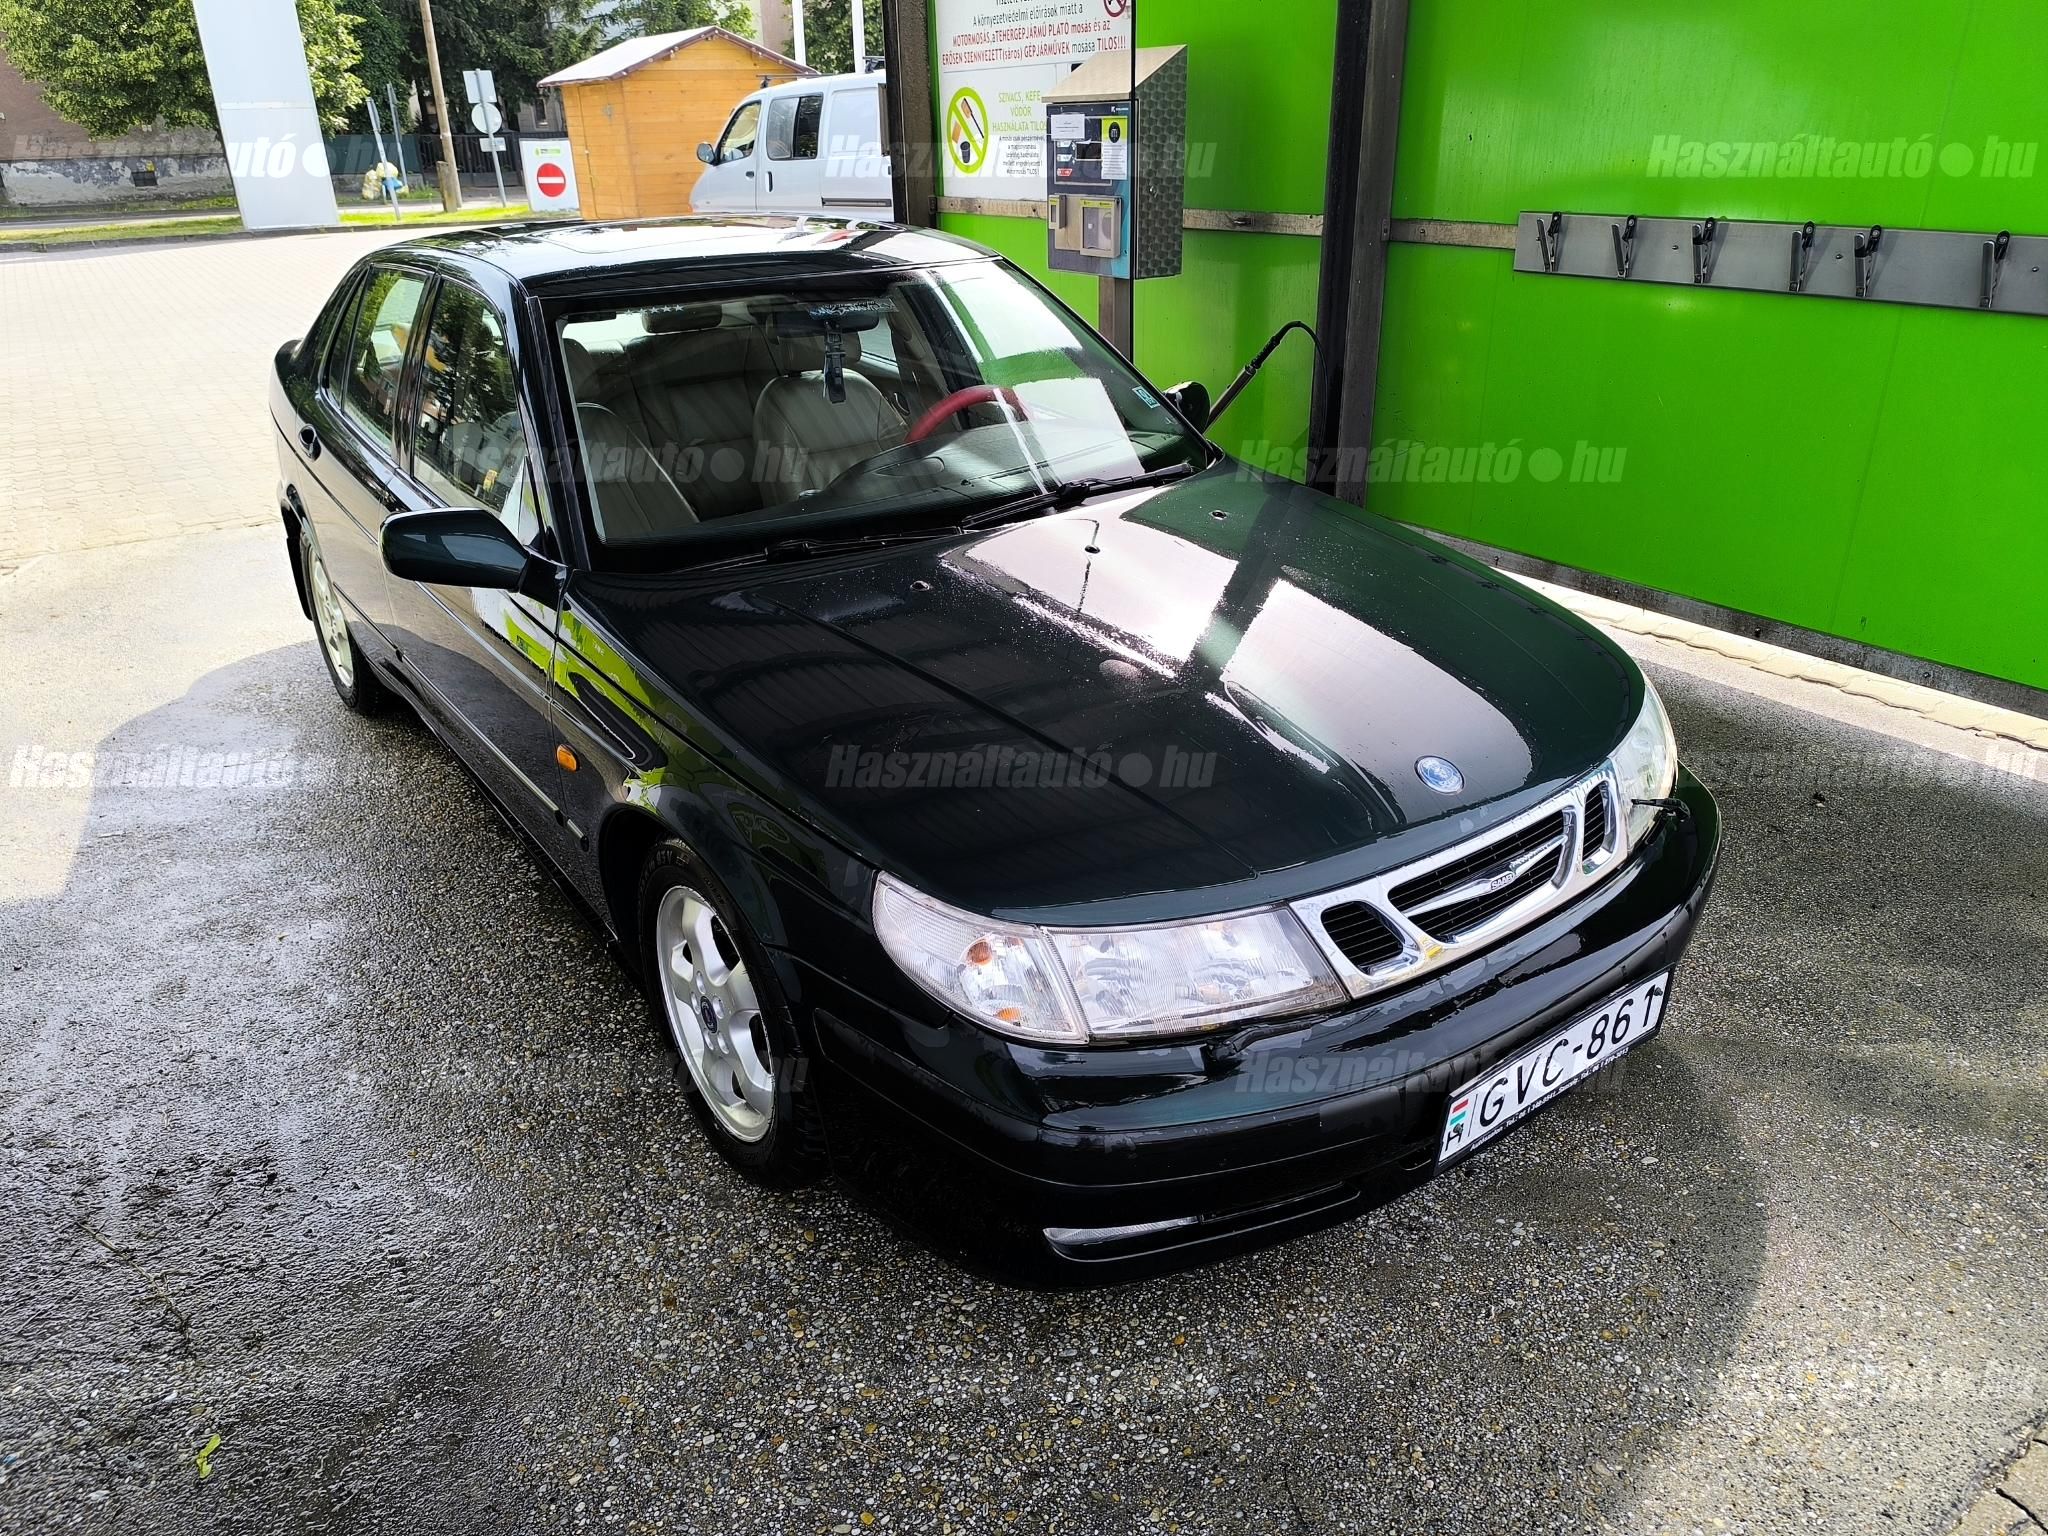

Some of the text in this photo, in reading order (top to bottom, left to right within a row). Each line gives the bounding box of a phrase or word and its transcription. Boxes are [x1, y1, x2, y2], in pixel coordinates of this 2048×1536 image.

[1060, 3, 1078, 16] miatt
[1079, 3, 1083, 14] a
[1070, 20, 1092, 34] mosás
[1093, 17, 1101, 31] és
[1102, 20, 1111, 31] az
[1071, 38, 1095, 53] mosása
[1097, 35, 1126, 51] TILOS!!!
[1480, 984, 1656, 1127] GVC-861
